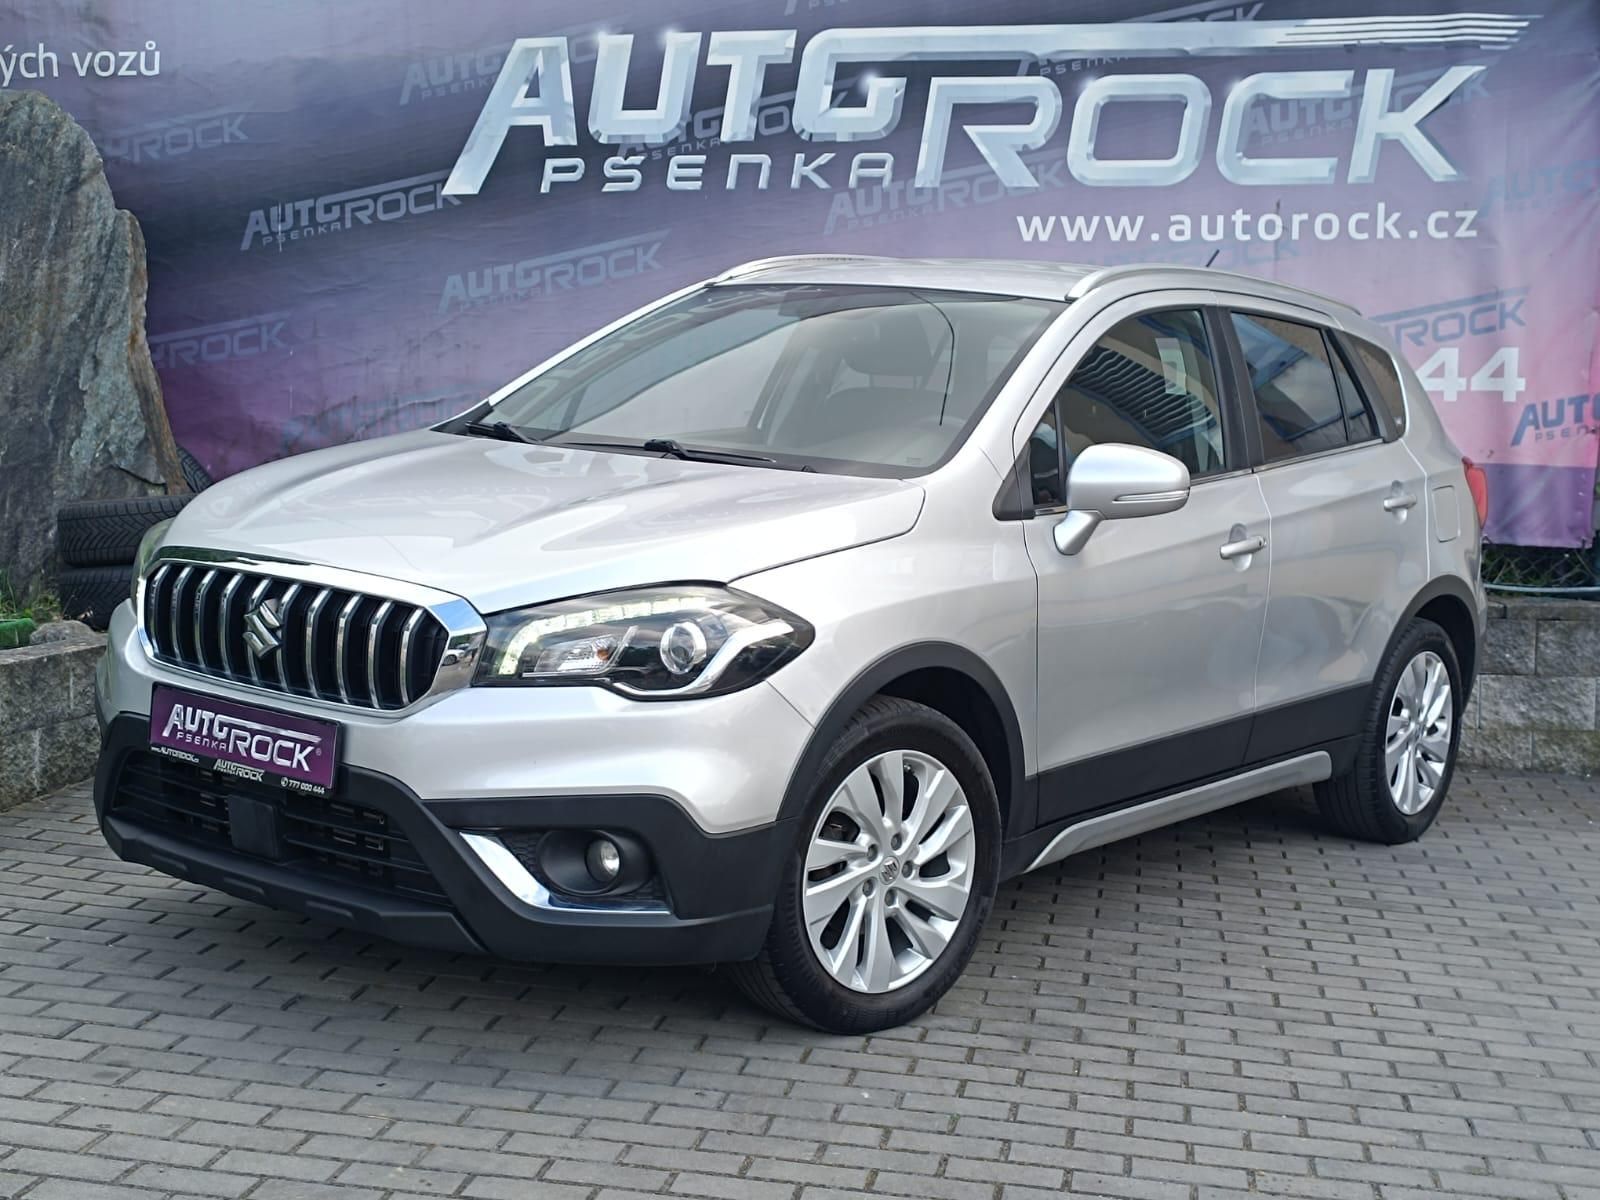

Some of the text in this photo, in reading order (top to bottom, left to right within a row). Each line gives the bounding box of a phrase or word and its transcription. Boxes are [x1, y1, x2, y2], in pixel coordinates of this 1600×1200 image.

[72, 40, 161, 77] vozů
[1016, 202, 1478, 242] www.autorock.cz
[1393, 298, 1527, 348] ROCK
[1415, 346, 1526, 402] 44
